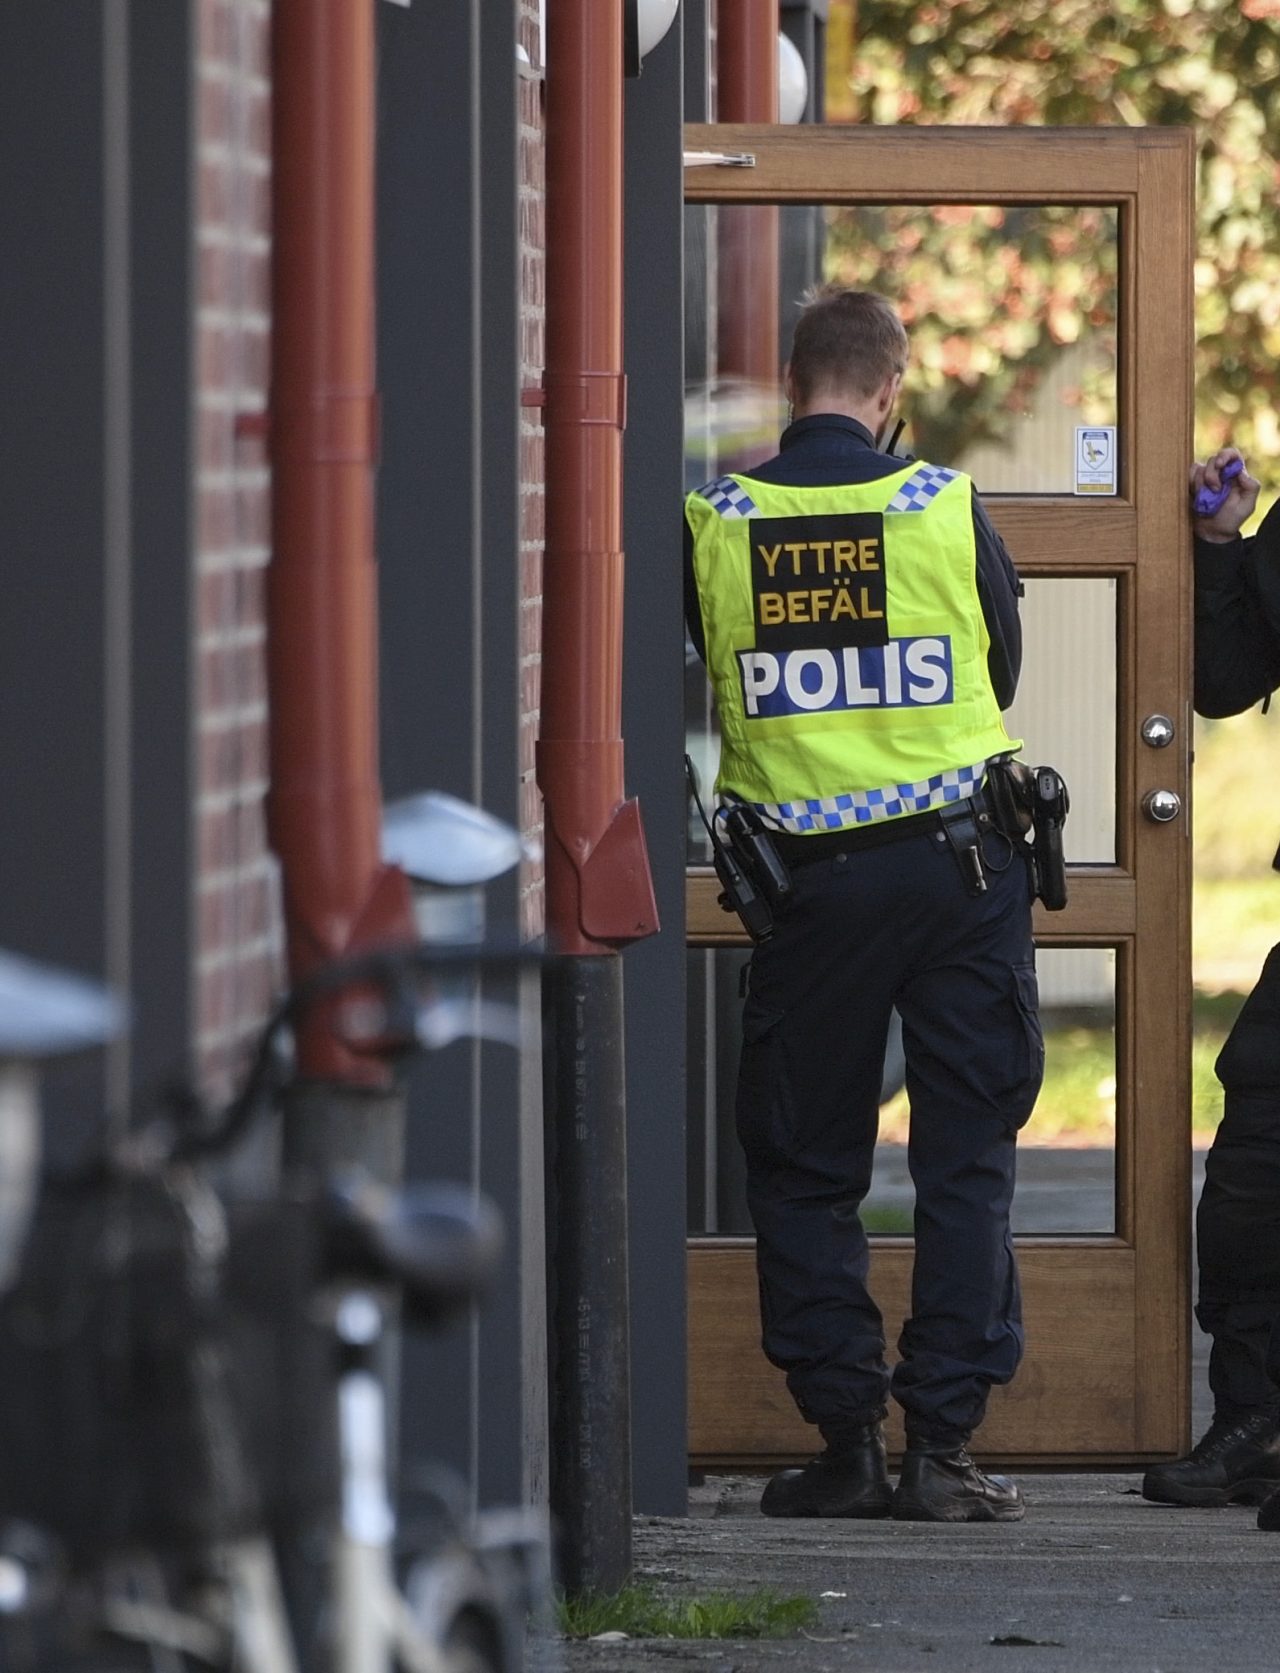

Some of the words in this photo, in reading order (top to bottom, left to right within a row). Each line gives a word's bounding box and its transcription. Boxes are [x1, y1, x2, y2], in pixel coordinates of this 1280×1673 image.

[758, 538, 879, 577] YTTRE
[758, 578, 883, 625] BEFÄL
[740, 639, 948, 714] POLIS
